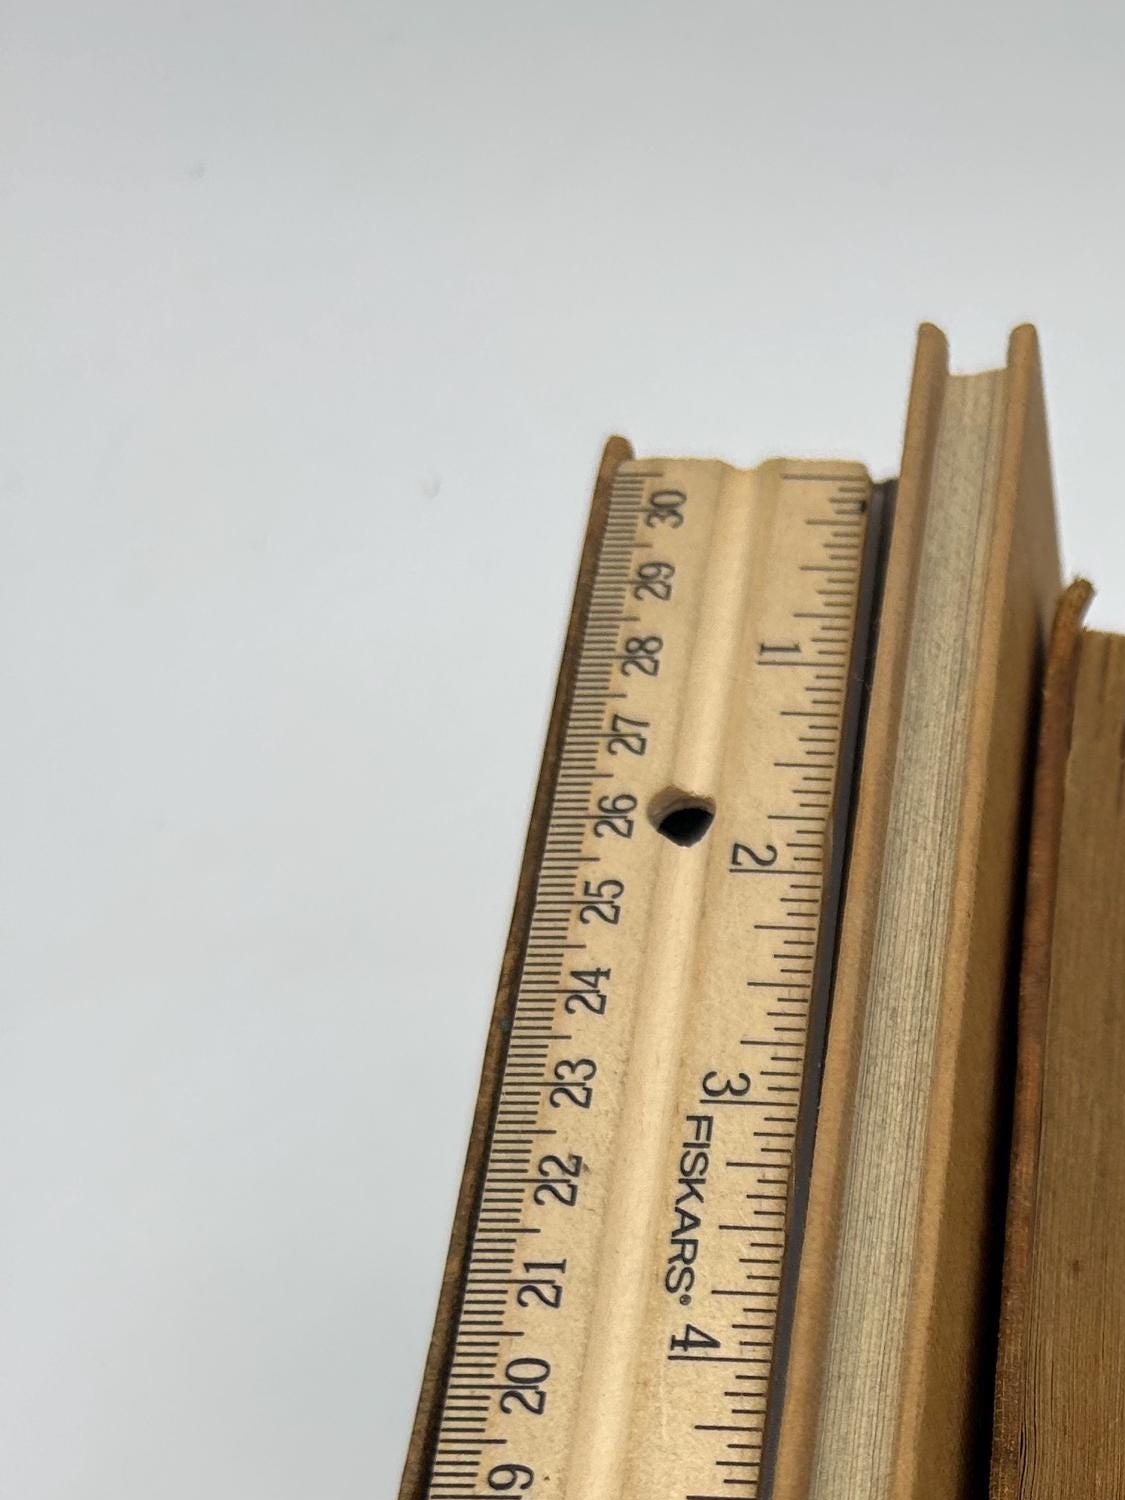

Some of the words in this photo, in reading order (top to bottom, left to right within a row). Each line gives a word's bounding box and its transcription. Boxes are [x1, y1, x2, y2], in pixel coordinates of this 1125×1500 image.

[645, 488, 688, 529] 30
[634, 561, 676, 601] 29
[621, 635, 664, 677] 28
[758, 642, 802, 656] 1
[608, 714, 650, 756] 27
[593, 793, 638, 840] 26
[731, 842, 778, 867] 2
[579, 880, 625, 925] 25
[564, 966, 612, 1016] 24
[549, 1057, 597, 1110] 23
[702, 1070, 751, 1097] 3
[533, 1154, 583, 1207] 22
[517, 1258, 568, 1309] 21
[670, 1323, 721, 1352] 4
[499, 1356, 552, 1415] 20
